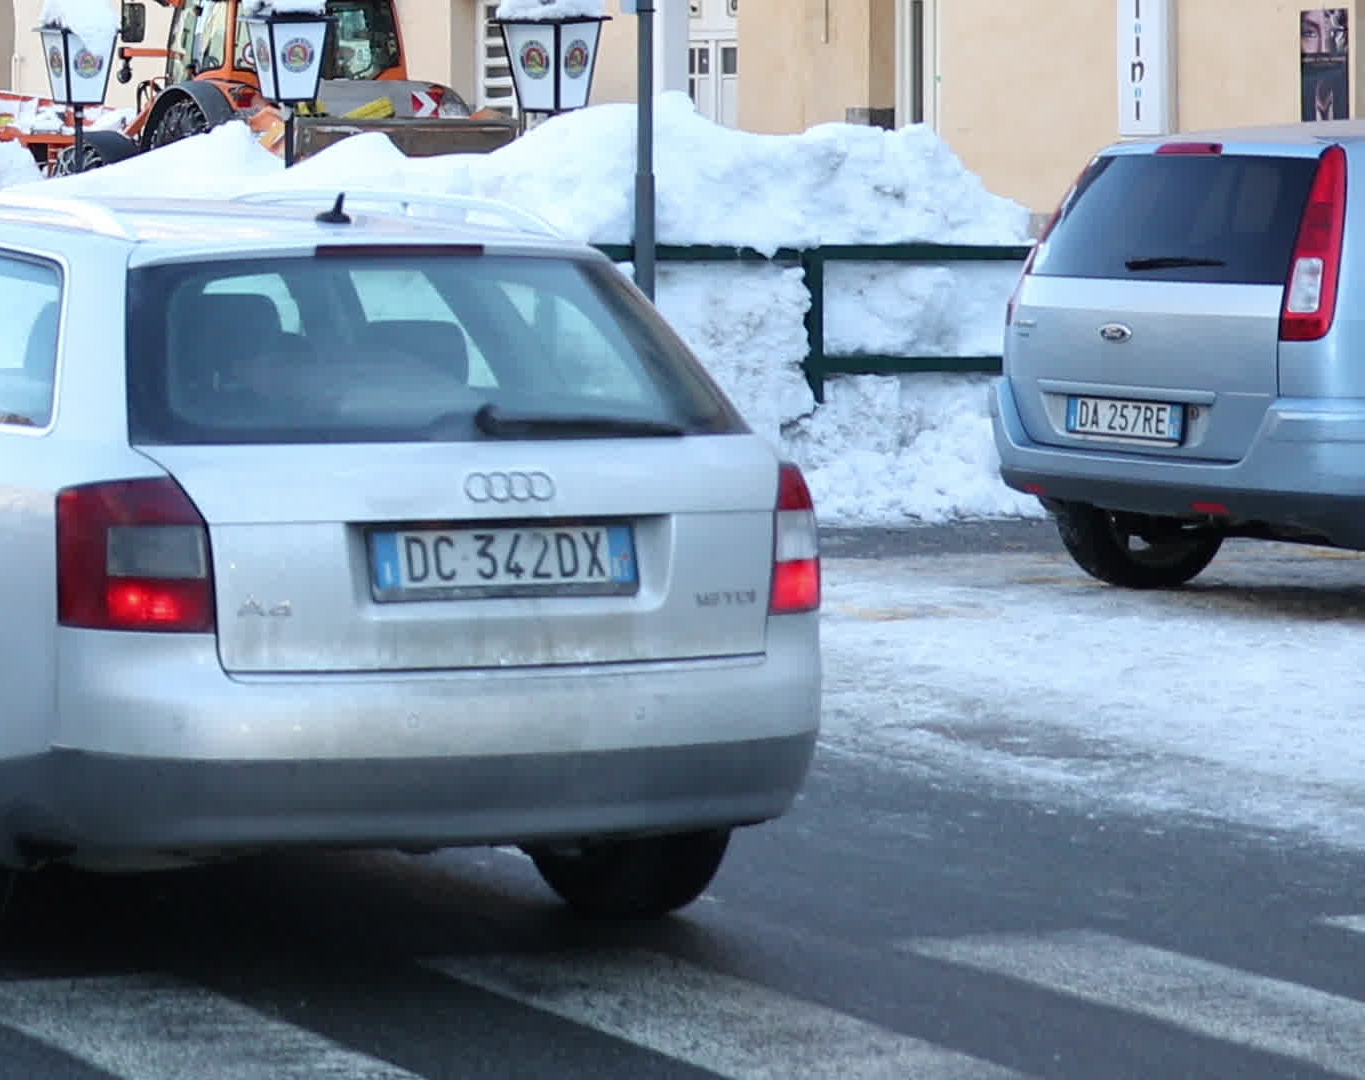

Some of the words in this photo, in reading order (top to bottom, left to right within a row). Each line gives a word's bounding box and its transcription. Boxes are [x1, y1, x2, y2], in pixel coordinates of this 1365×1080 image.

[1079, 401, 1099, 429] DA
[1107, 403, 1167, 436] 257RE
[404, 535, 457, 583] DC
[472, 530, 606, 580] 342DX
